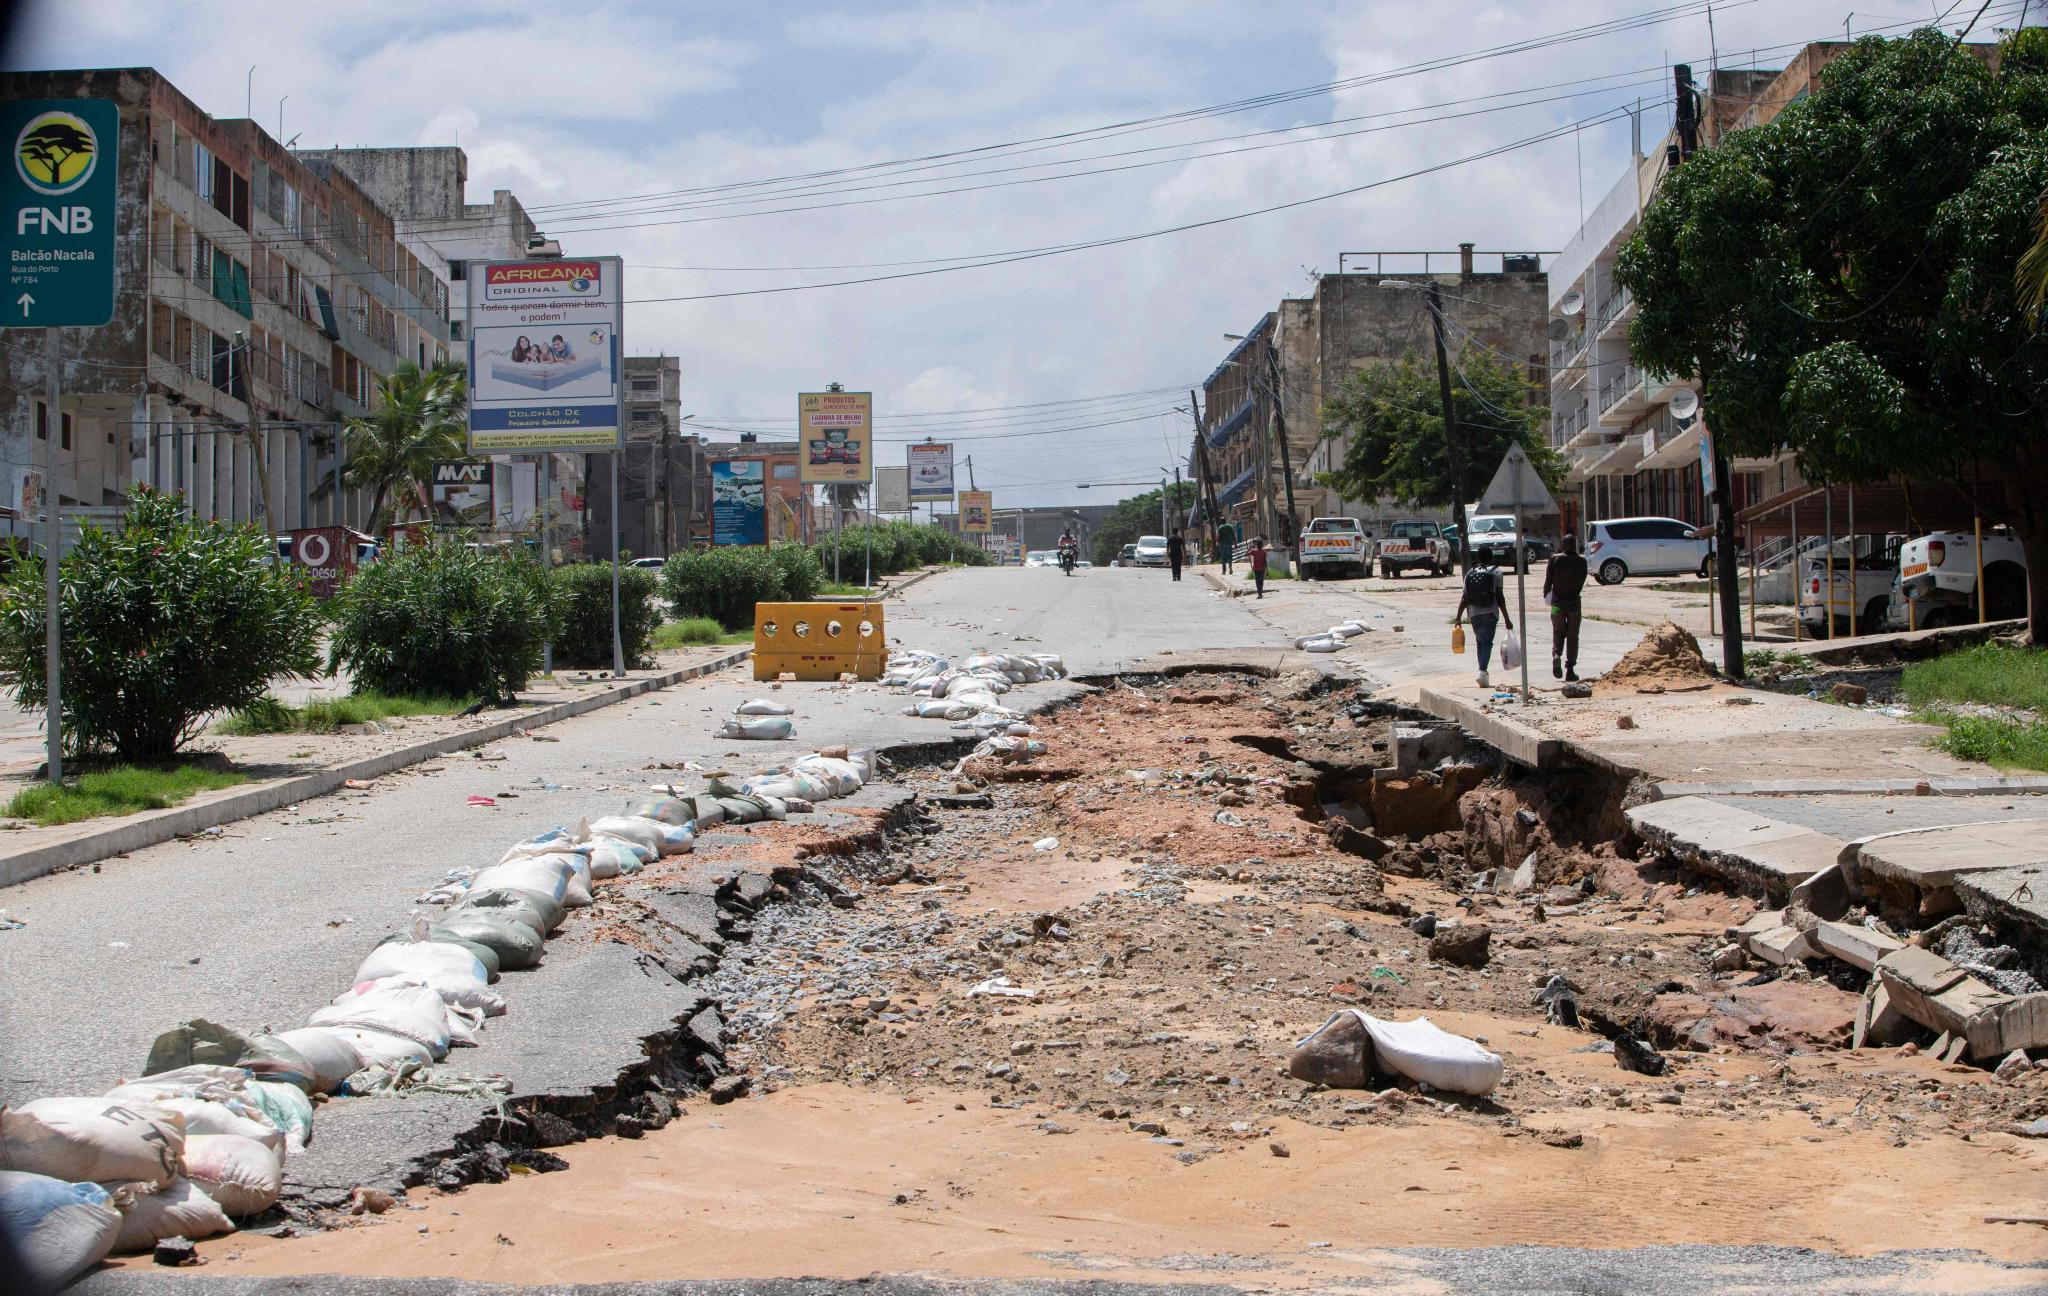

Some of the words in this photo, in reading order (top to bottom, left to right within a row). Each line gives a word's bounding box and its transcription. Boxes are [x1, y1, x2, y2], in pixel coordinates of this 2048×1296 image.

[18, 206, 94, 235] FNB
[11, 249, 52, 261] Balcão
[53, 248, 95, 261] Nacala
[12, 265, 27, 273] Rua
[27, 265, 37, 273] do
[38, 265, 59, 273] Porto
[491, 267, 595, 281] AFRICANA
[493, 286, 560, 295] ORIGINAL
[480, 303, 509, 311] Todos
[511, 303, 547, 313] querem
[529, 313, 561, 323] podem
[823, 396, 856, 404] PRODUTOS
[541, 418, 580, 426] Qualidade
[437, 465, 485, 481] MAT
